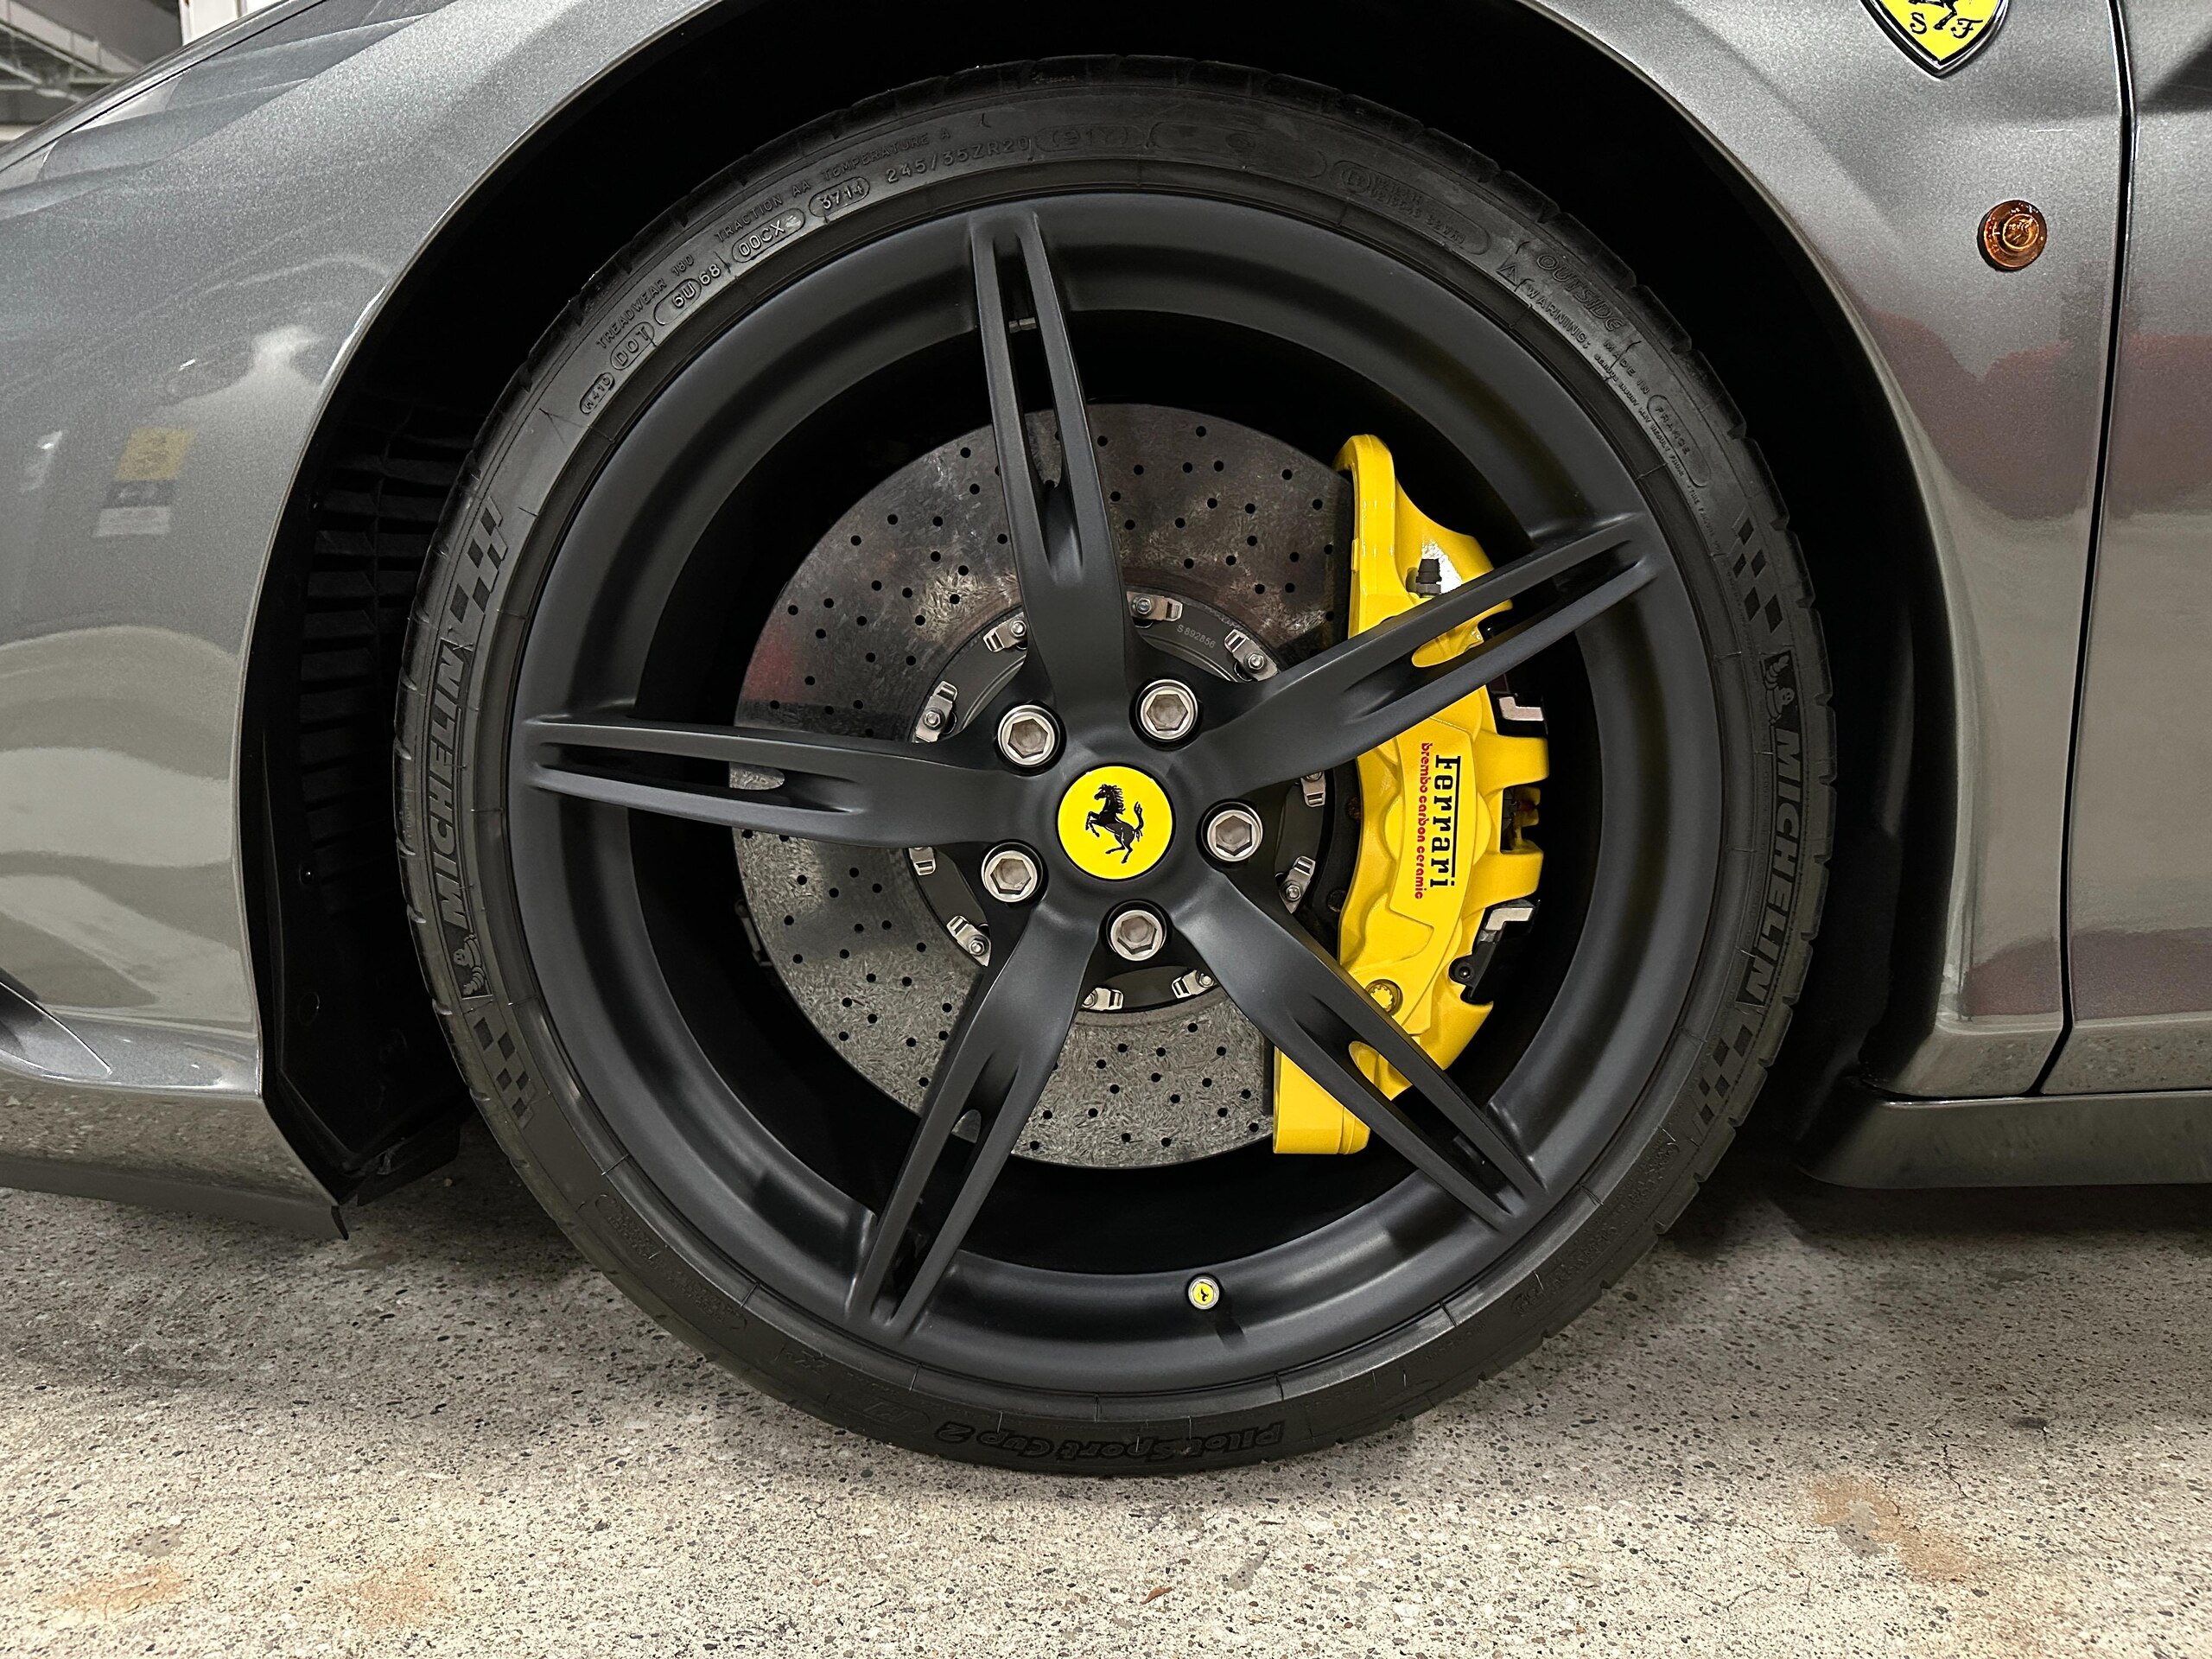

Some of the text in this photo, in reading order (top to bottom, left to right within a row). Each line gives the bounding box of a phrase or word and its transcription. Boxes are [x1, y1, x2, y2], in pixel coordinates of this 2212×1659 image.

[1910, 12, 1983, 39] S F
[882, 133, 1031, 186] 245/35ZR20
[594, 275, 668, 351] TREADWEAR
[669, 252, 696, 277] 180
[713, 192, 785, 245] TRACTION
[788, 178, 812, 198] AA
[819, 130, 931, 184] TEMPERATURE
[613, 324, 653, 367] DOT
[817, 178, 865, 211] 3714
[1536, 253, 1625, 333] OUTSIDE
[1602, 338, 1637, 378] MADE
[1635, 378, 1651, 396] IN
[430, 648, 468, 929] MICHELIN
[1414, 742, 1433, 899] brembo carbon ceramic
[1430, 754, 1461, 887] Ferrari
[1745, 728, 1800, 1001] MICHELIN
[936, 1421, 1282, 1459] Pilot Sport Cup 2
